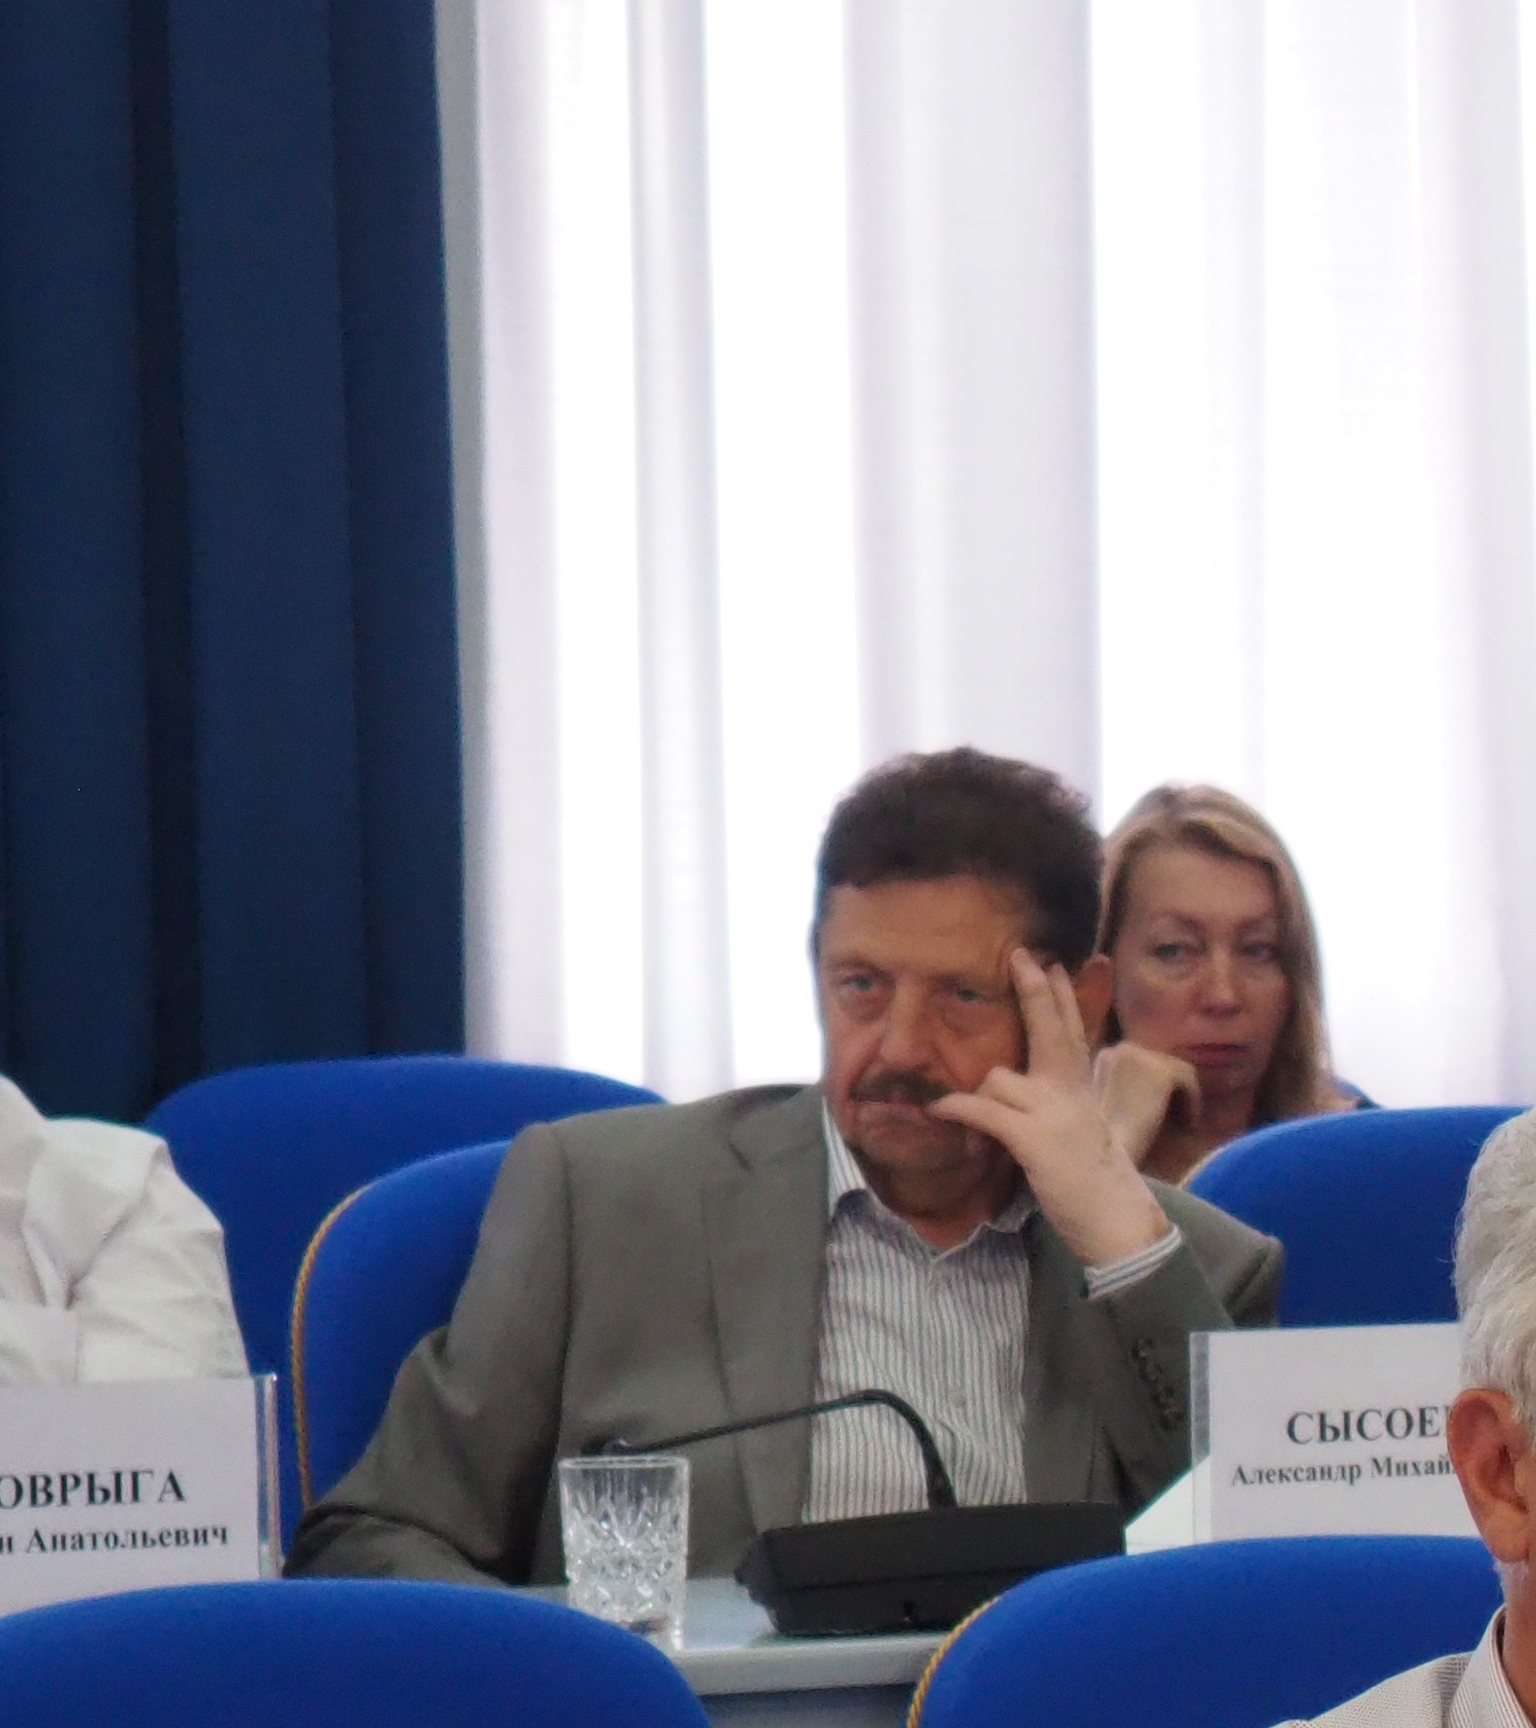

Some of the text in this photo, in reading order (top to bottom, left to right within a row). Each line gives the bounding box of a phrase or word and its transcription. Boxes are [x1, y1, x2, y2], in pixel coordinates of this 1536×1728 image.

[1285, 1404, 1452, 1446] СЫСОЕ
[0, 1469, 187, 1510] ОВРЫГА
[1232, 1453, 1457, 1488] Александр Михай
[26, 1525, 229, 1554] Анатольевич
